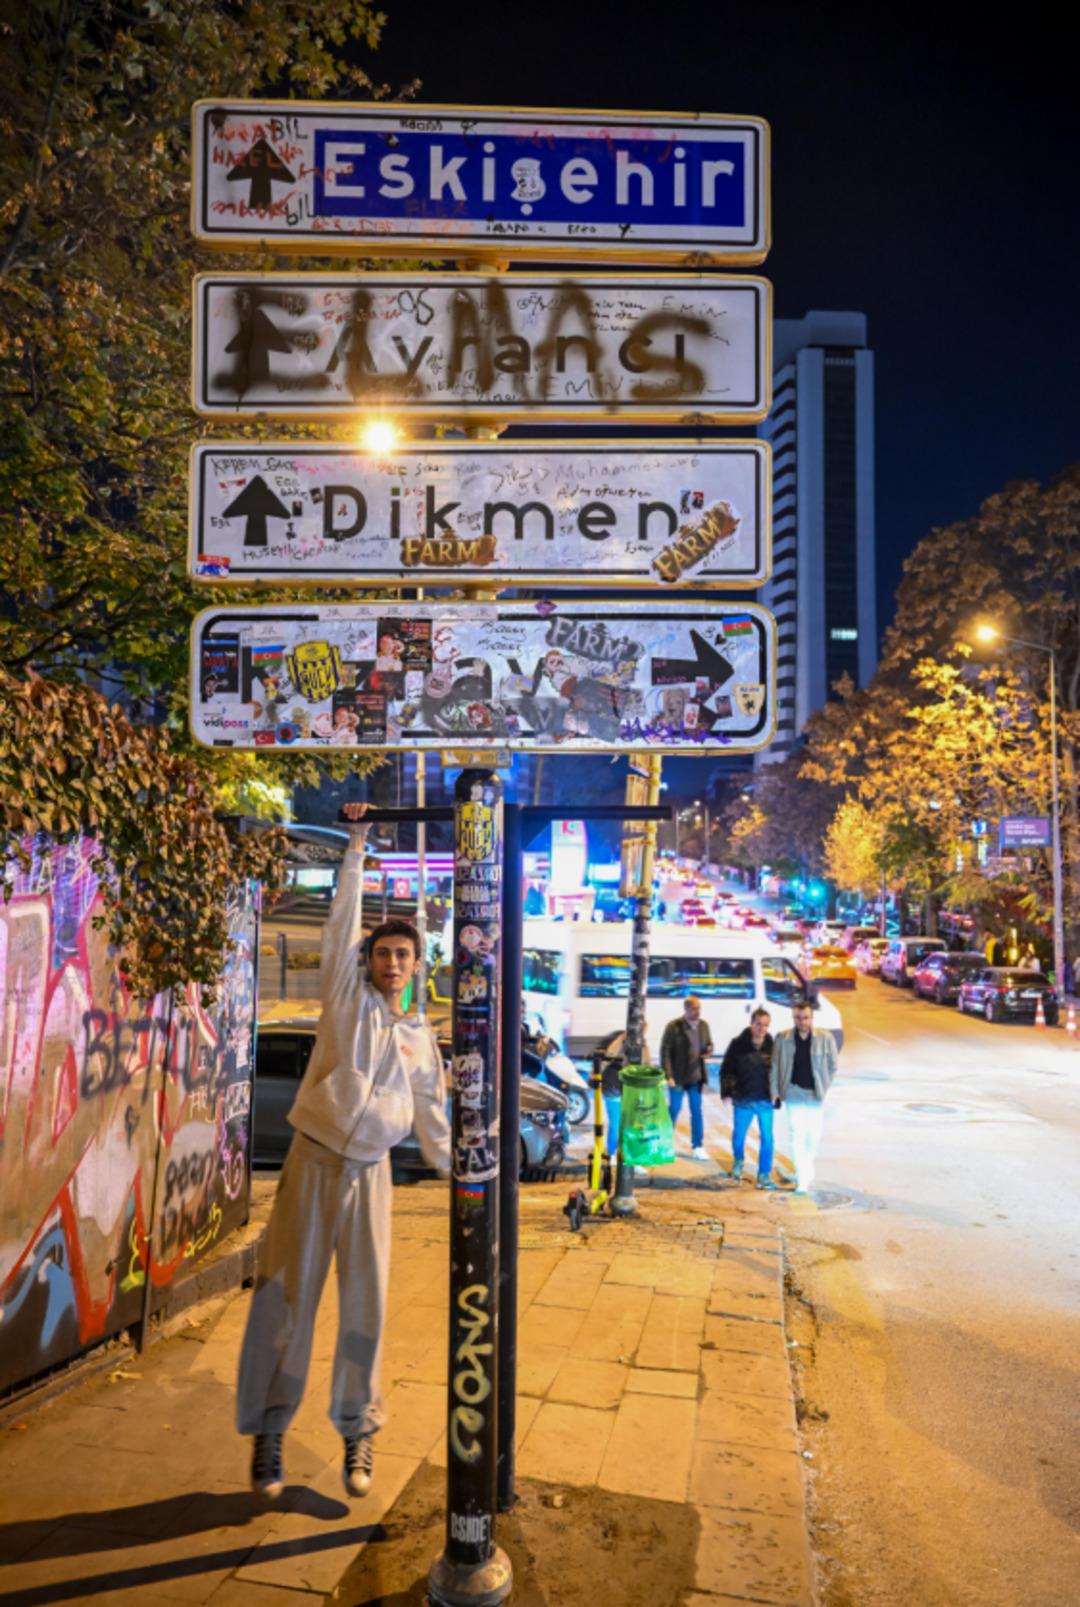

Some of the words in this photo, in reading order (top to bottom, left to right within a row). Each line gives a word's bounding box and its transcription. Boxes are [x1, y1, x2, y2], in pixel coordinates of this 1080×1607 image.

[324, 141, 735, 215] Eskişehir
[323, 485, 678, 541] Dikmen
[404, 537, 478, 565] FARM
[549, 617, 625, 661] FARM
